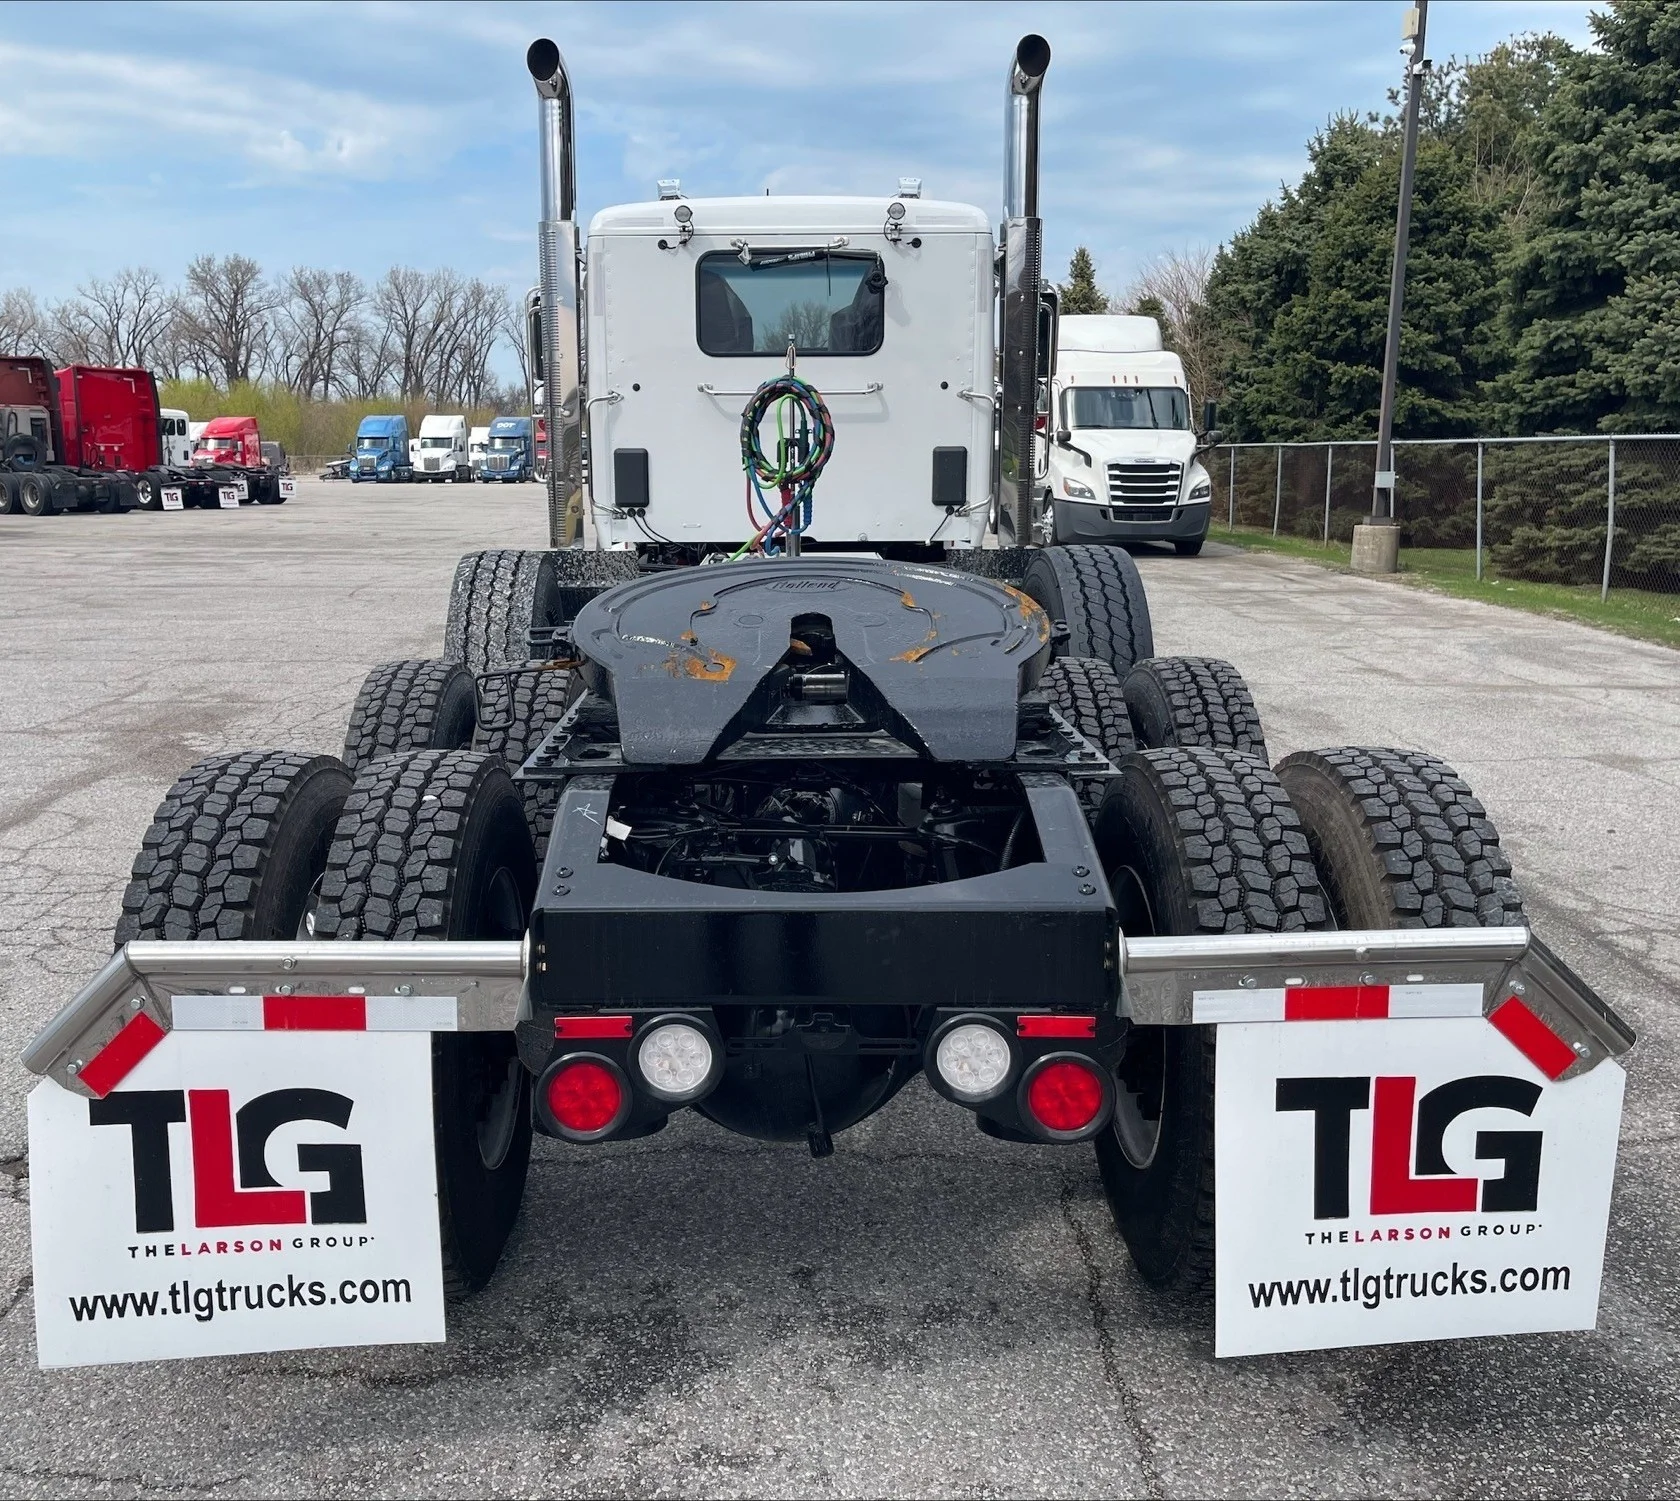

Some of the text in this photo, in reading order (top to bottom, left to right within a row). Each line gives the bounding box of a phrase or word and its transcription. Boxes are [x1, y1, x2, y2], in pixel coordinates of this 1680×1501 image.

[164, 492, 178, 501] TLG
[221, 491, 235, 500] TLG
[89, 1087, 367, 1234] TLG
[1275, 1075, 1544, 1220] TLG
[293, 1236, 368, 1249] GROUP
[1461, 1223, 1535, 1237] GROUP
[69, 1274, 412, 1322] www.tlgtrucks.com
[1248, 1262, 1571, 1310] www.tlgtrucks.com
